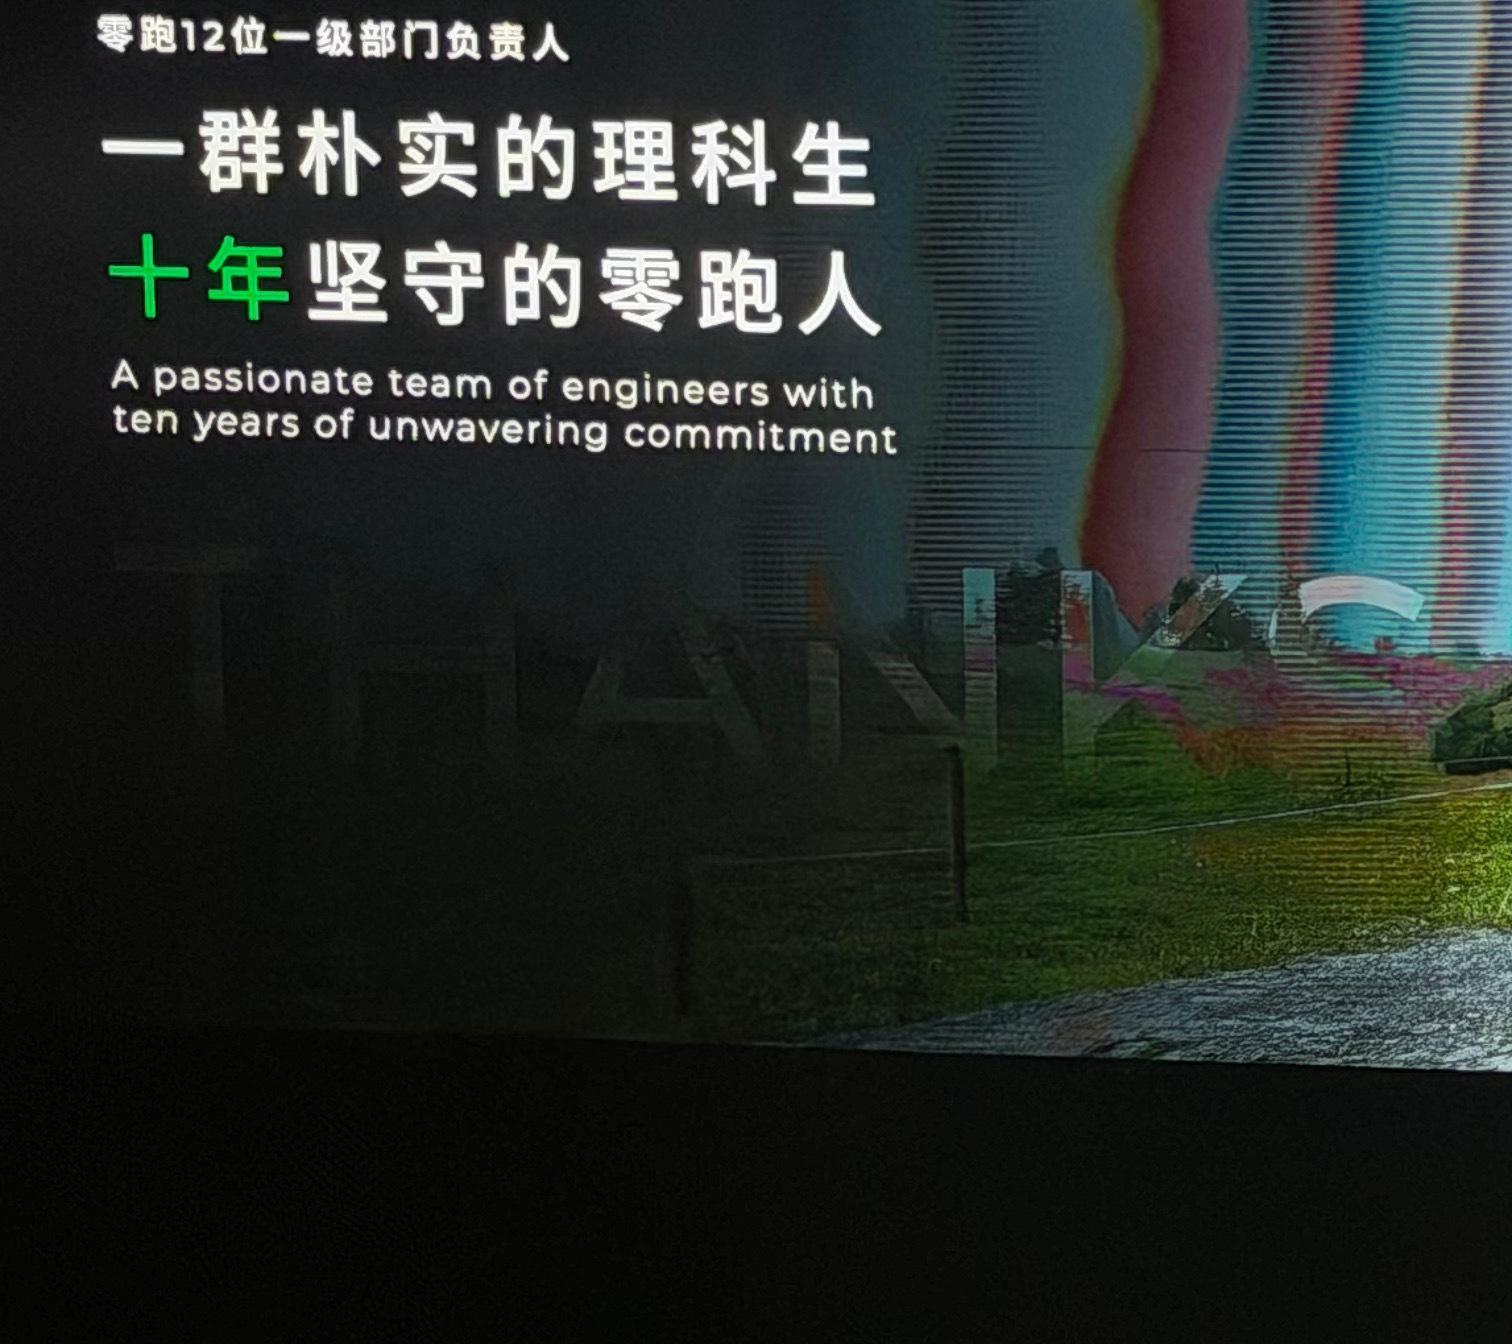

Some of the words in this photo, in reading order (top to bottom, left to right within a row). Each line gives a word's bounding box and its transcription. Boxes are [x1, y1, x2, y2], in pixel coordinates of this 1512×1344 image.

[97, 13, 571, 63] 零跑12位一级部门负责人
[101, 108, 877, 208] 一群朴实的理科生
[108, 233, 883, 338] 十年坚守的零跑人
[111, 359, 139, 390] A
[154, 362, 374, 397] passionate
[388, 369, 492, 400] team
[508, 369, 549, 401] of
[562, 372, 770, 409] engineers
[783, 377, 874, 410] with
[113, 405, 178, 435] ten
[193, 409, 300, 442] years
[313, 408, 355, 439] of
[369, 413, 608, 453] unwavering
[623, 420, 898, 455] commitment
